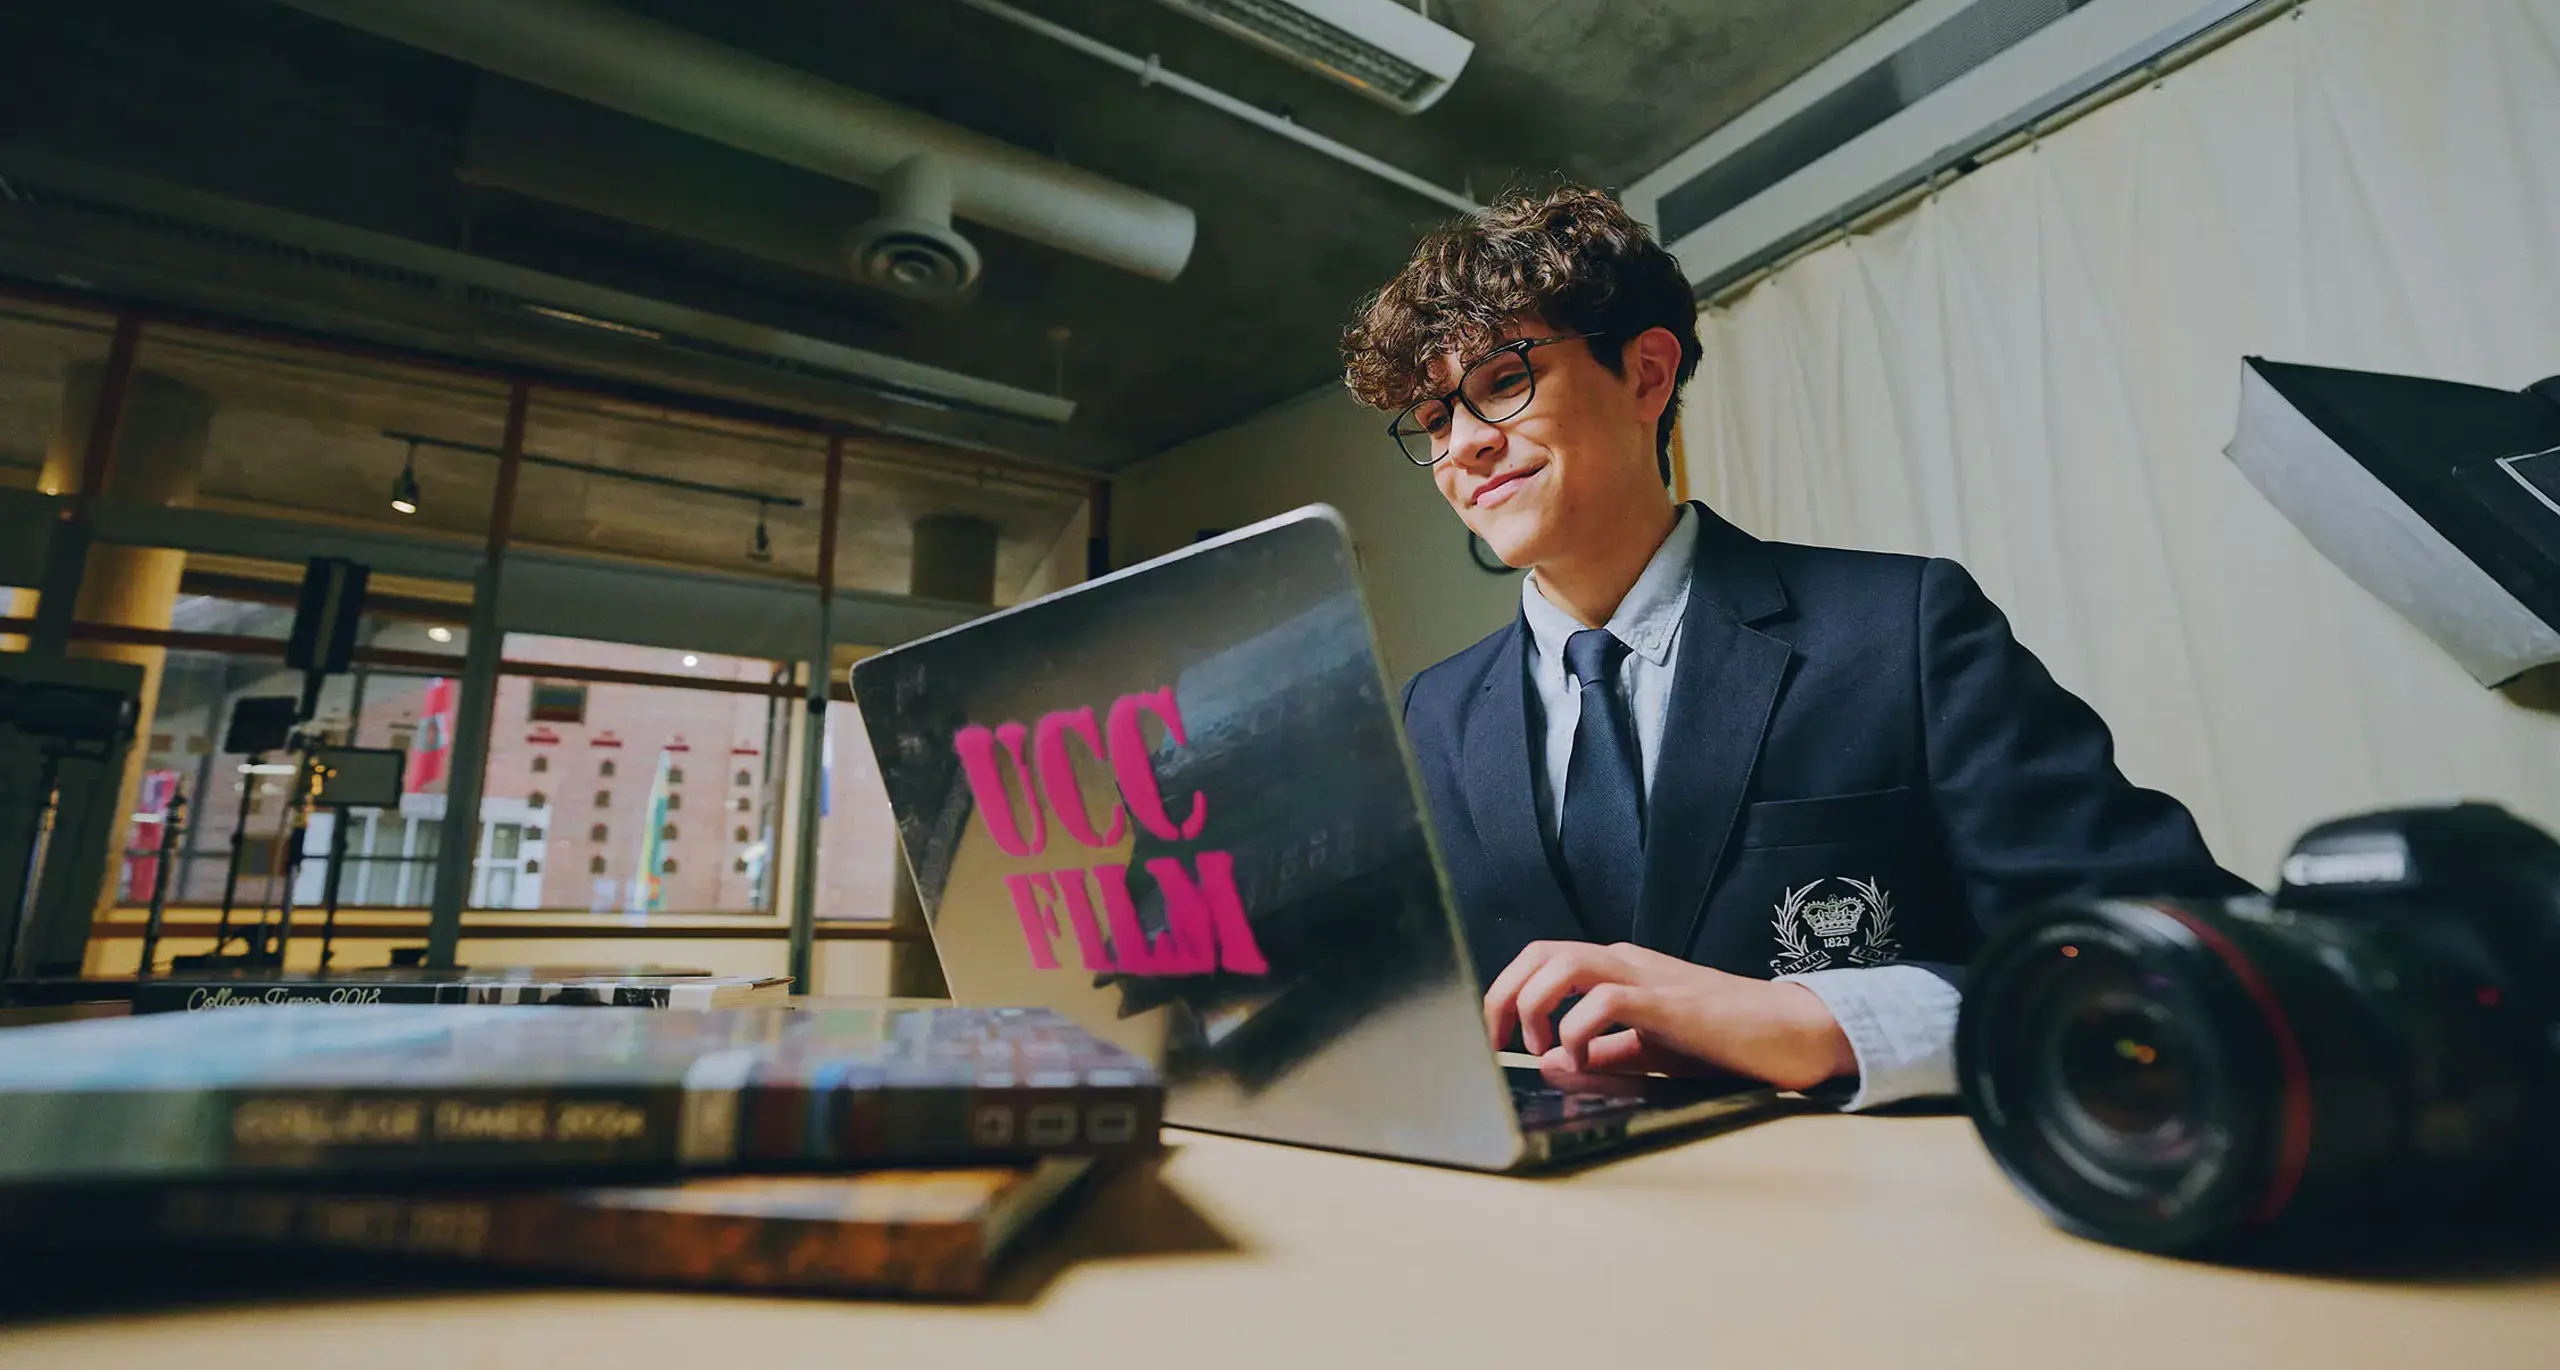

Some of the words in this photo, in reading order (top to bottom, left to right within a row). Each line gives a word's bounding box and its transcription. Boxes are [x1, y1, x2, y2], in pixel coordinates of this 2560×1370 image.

[955, 685, 1207, 857] UCC
[1004, 850, 1269, 976] FILM
[1823, 936, 1850, 948] 1829
